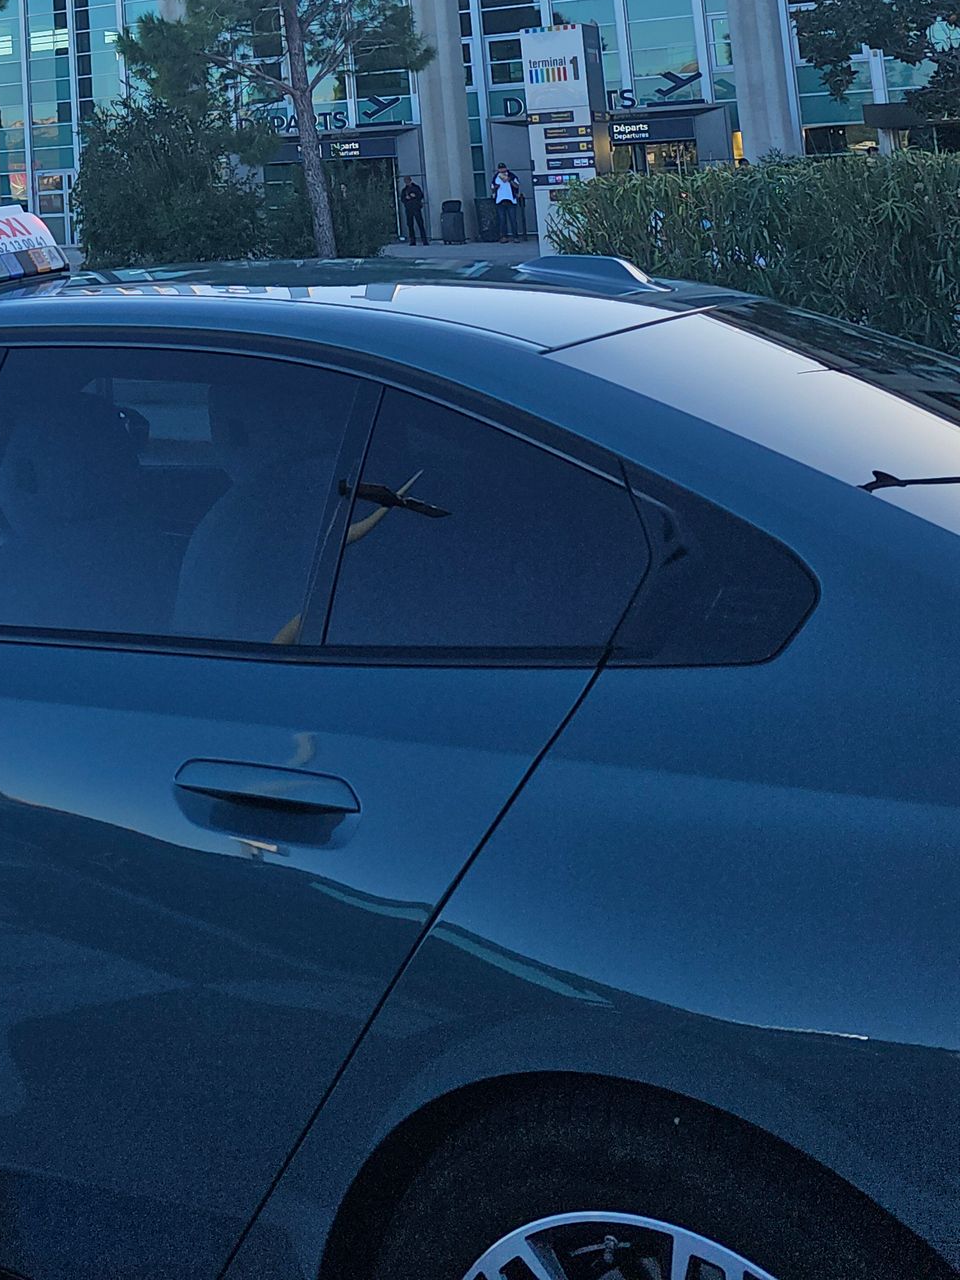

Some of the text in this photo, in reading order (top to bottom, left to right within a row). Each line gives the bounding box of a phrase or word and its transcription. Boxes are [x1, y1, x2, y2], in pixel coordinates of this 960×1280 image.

[528, 56, 566, 69] terminal
[570, 56, 580, 81] 1
[613, 124, 649, 133] Départs
[10, 240, 23, 251] 13
[22, 238, 36, 249] 00
